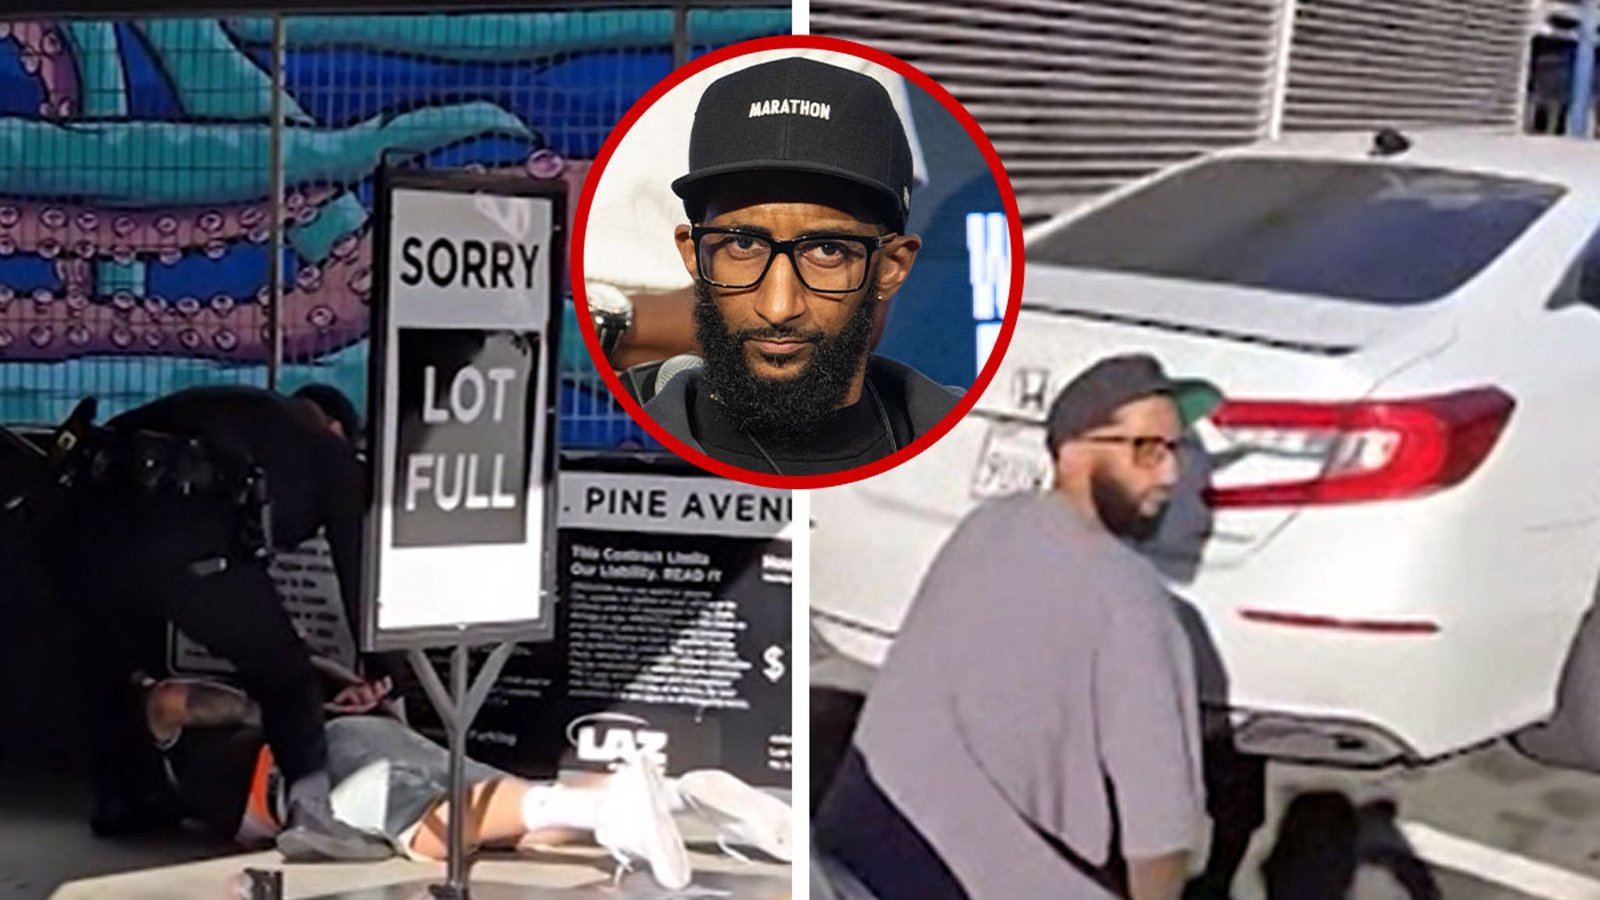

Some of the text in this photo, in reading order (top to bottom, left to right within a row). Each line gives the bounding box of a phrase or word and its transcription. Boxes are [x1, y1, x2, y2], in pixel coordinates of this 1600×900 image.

[748, 98, 830, 121] MARATHON
[400, 237, 540, 290] SORRY
[422, 365, 516, 424] LOT
[405, 453, 517, 511] FULL
[585, 487, 667, 518] PINE
[570, 561, 597, 576] Our
[663, 567, 705, 582] READ
[707, 569, 723, 583] IT
[571, 544, 711, 566] This Contract Limits
[763, 646, 785, 682] $
[577, 726, 668, 765] LAZ
